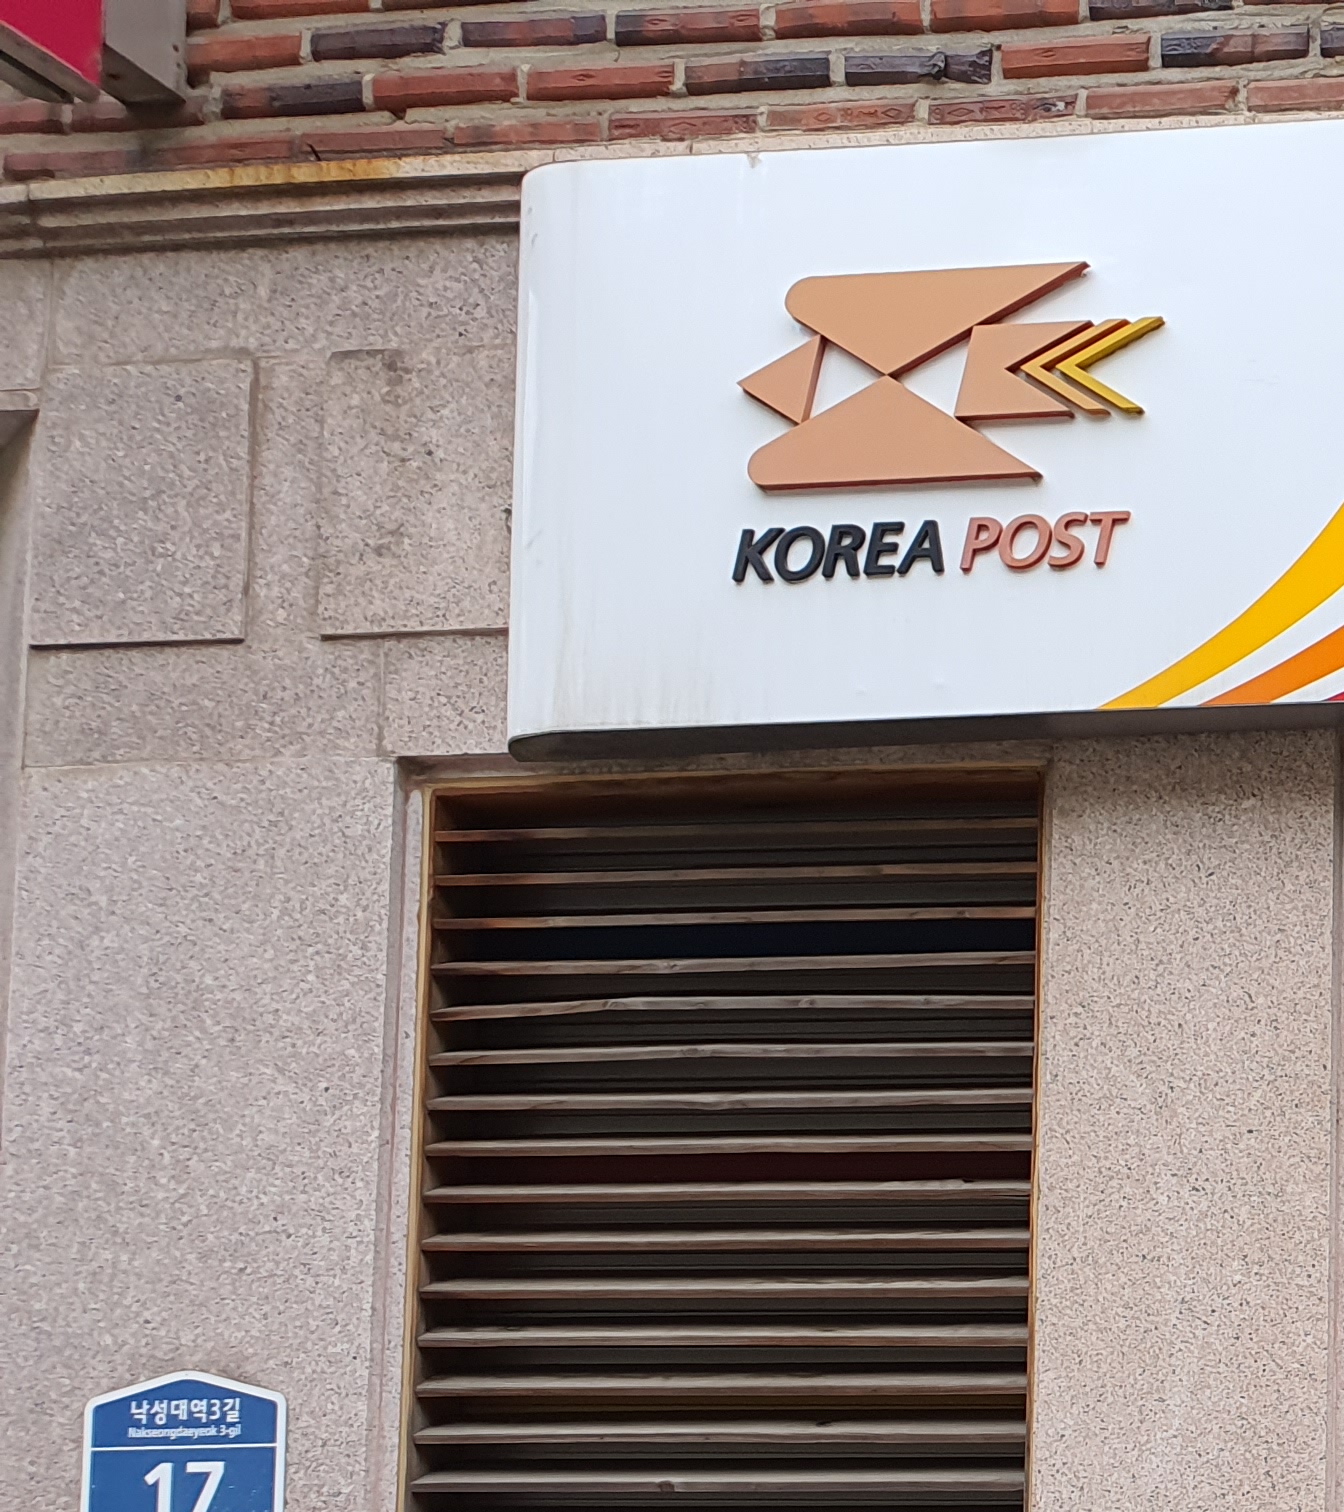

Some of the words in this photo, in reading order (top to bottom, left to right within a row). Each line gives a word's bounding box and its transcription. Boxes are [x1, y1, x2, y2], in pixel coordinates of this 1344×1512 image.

[732, 519, 945, 583] KOREA
[960, 509, 1131, 573] POST
[130, 1398, 241, 1424] 낙성대역3길
[219, 1423, 241, 1438] 3-gil
